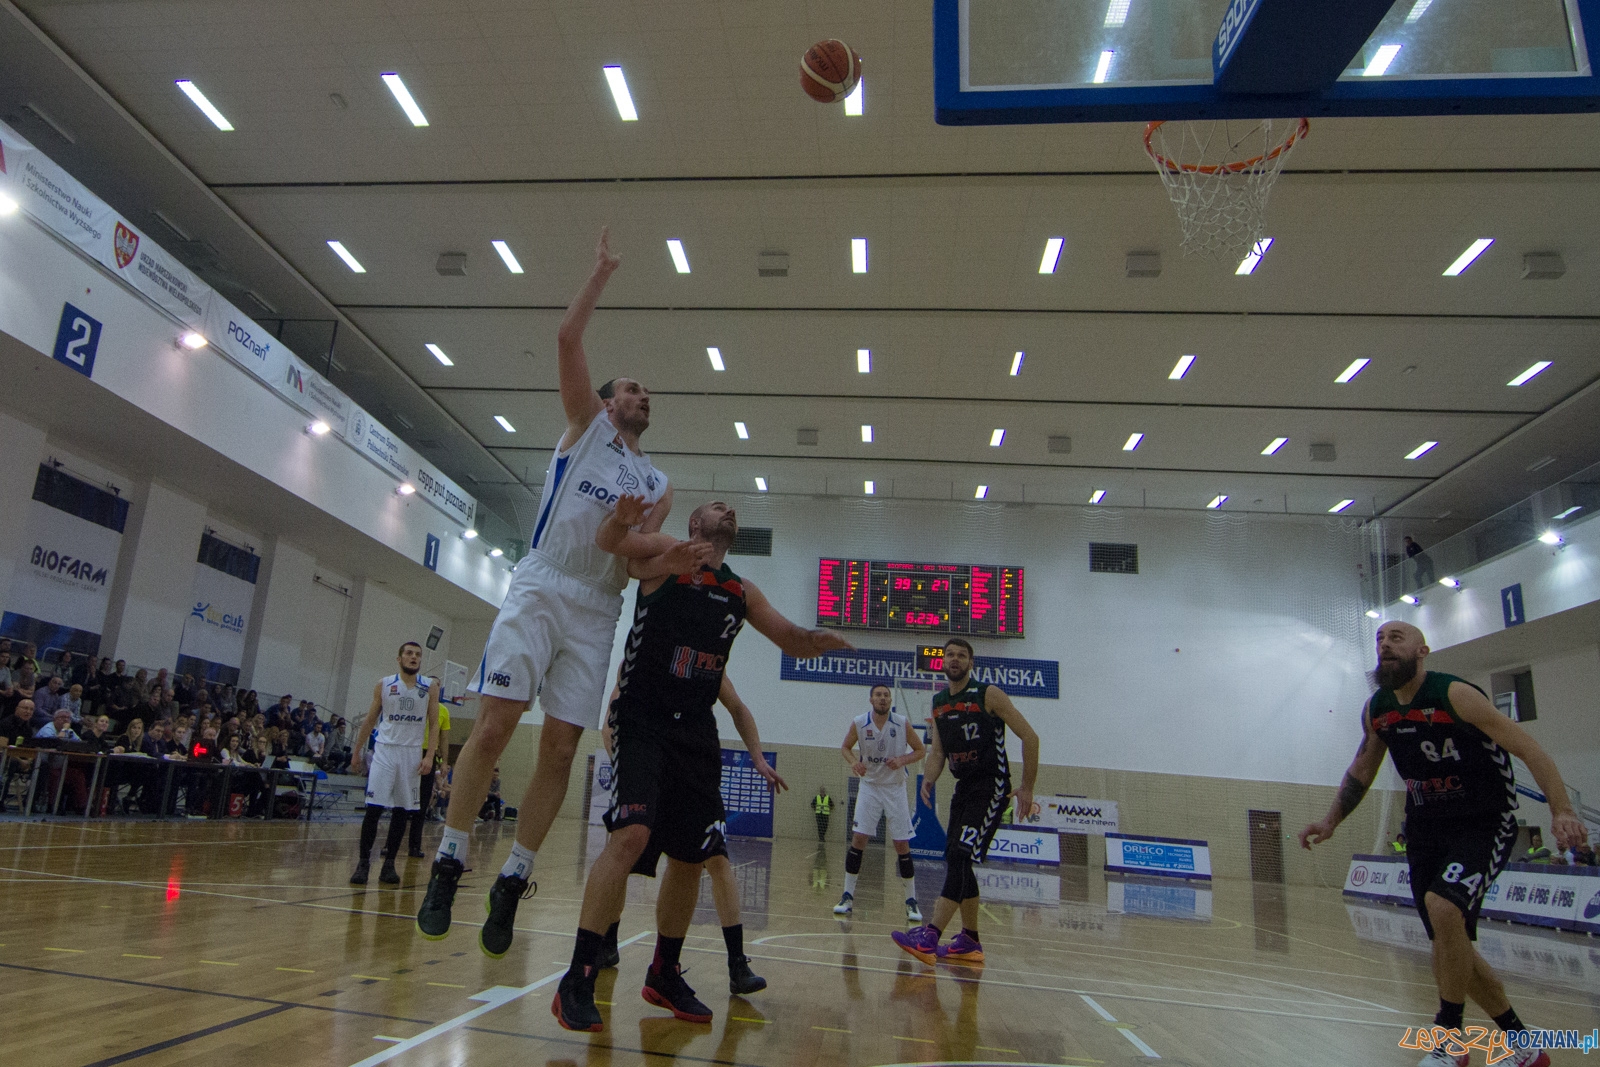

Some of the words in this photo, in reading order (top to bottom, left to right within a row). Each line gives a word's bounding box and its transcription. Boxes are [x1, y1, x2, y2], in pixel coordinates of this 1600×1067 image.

[1219, 0, 1250, 56] SPO
[26, 162, 71, 203] Ministerstwo
[71, 198, 93, 219] Nauki
[26, 178, 68, 216] Szkolnictwa
[65, 317, 92, 367] 2
[616, 464, 640, 498] 12
[578, 480, 620, 508] BIOF
[30, 545, 107, 586] BIOFARM
[429, 540, 436, 566] 1
[894, 577, 911, 591] 39
[931, 579, 949, 592] 27
[1507, 590, 1519, 622] 1
[930, 657, 943, 671] 10
[399, 696, 415, 712] 10
[961, 722, 980, 741] 12
[1420, 737, 1461, 762] 84
[231, 796, 242, 812] 5
[411, 787, 419, 801] 1
[1056, 804, 1102, 818] MAXXX
[1066, 816, 1077, 824] hit
[1091, 818, 1116, 827] hitem
[960, 825, 979, 847] 12
[1442, 862, 1483, 896] 84
